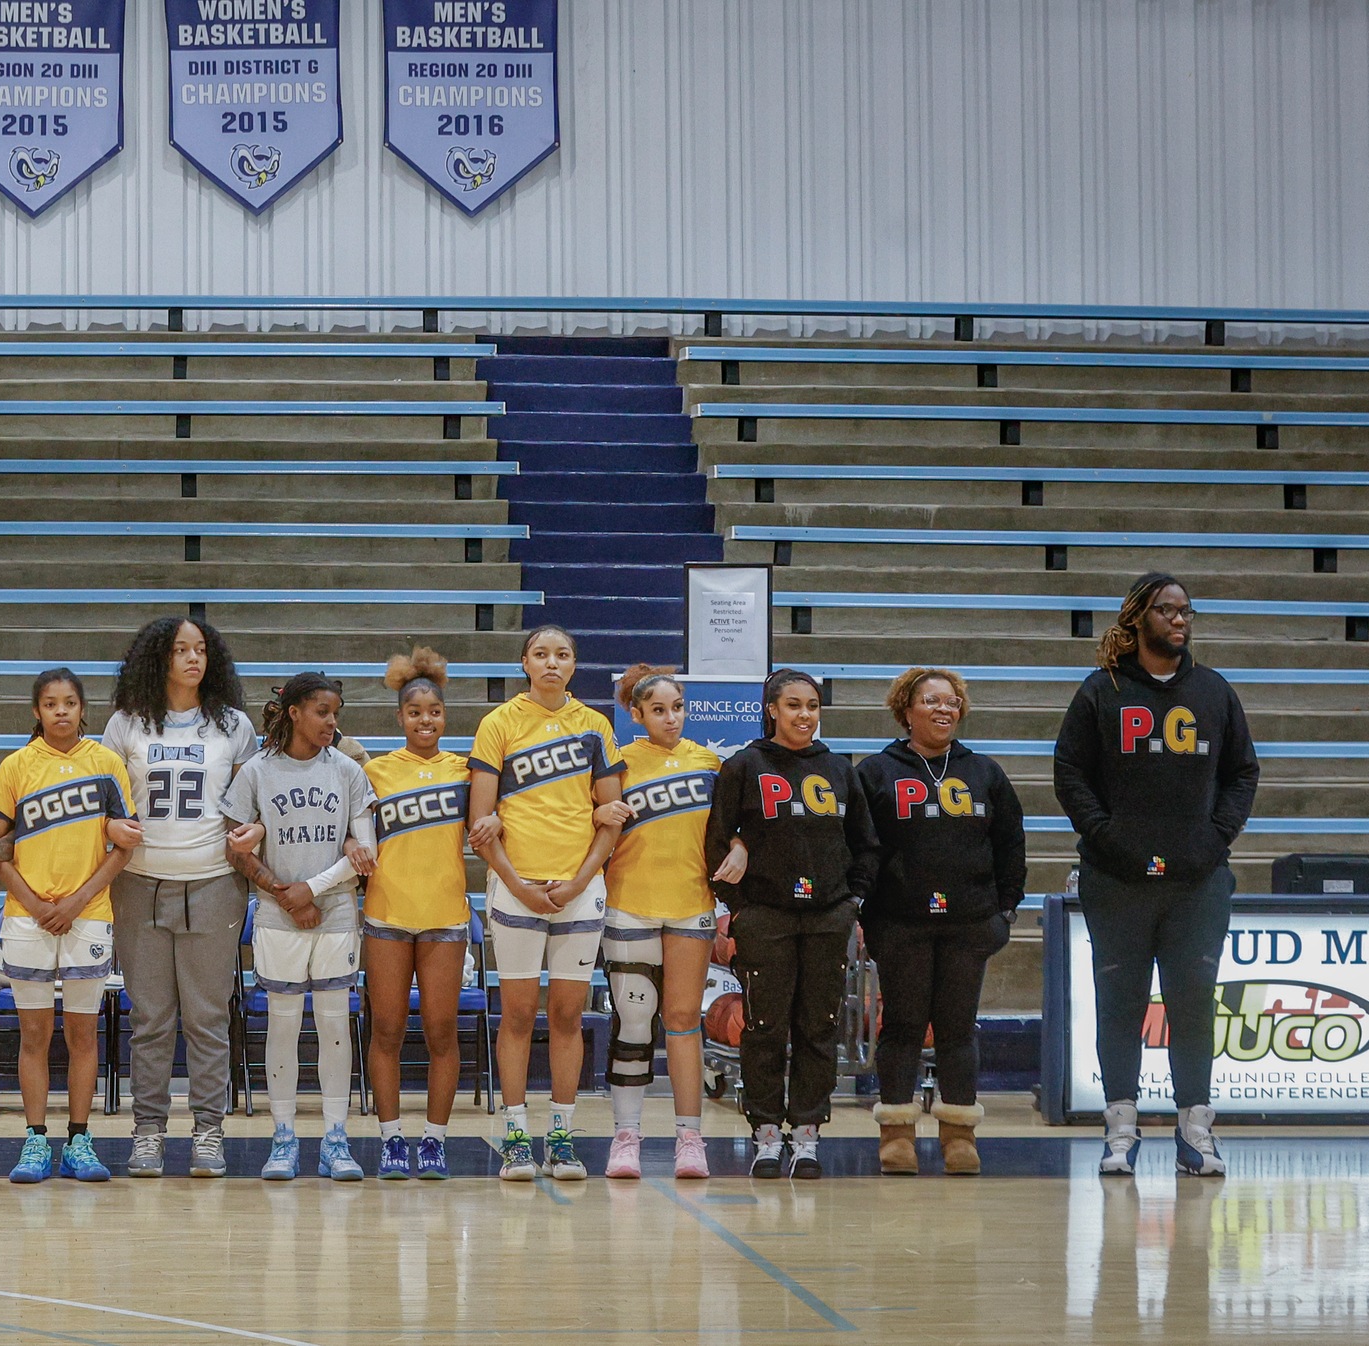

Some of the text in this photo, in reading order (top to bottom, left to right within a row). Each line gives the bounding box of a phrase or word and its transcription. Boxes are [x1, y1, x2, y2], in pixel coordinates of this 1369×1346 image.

[0, 2, 72, 24] MEN'S
[198, 0, 306, 20] WOMEN'S
[434, 2, 506, 23] MEN'S
[178, 23, 327, 46] BASKETBALL
[396, 26, 543, 49] BASKETBALL
[41, 63, 63, 78] 20
[70, 64, 99, 79] DIII
[188, 59, 319, 76] DIII DISTRICT G
[408, 62, 532, 78] REGION 20 DIII
[182, 82, 327, 105] CHAMPIONS
[398, 85, 543, 107] CHAMPIONS
[1, 114, 68, 136] 2015
[221, 111, 288, 133] 2015
[437, 114, 504, 136] 2016
[689, 700, 731, 712] PRINCE
[689, 714, 763, 723] COMMUNITY COLL
[1120, 706, 1210, 756] P.G.
[147, 743, 205, 764] OWLS
[512, 742, 589, 784] PGCC
[145, 768, 207, 821] 22
[270, 786, 340, 817] PGCC
[625, 778, 709, 820] PGCC
[758, 773, 846, 820] P.G.
[895, 777, 986, 820] P.G.
[23, 784, 101, 829] PGCC
[380, 790, 459, 830] PGCC
[278, 824, 337, 846] MADE
[1216, 1072, 1296, 1084] JUNIOR
[1230, 1087, 1369, 1099] CONFERENCE
